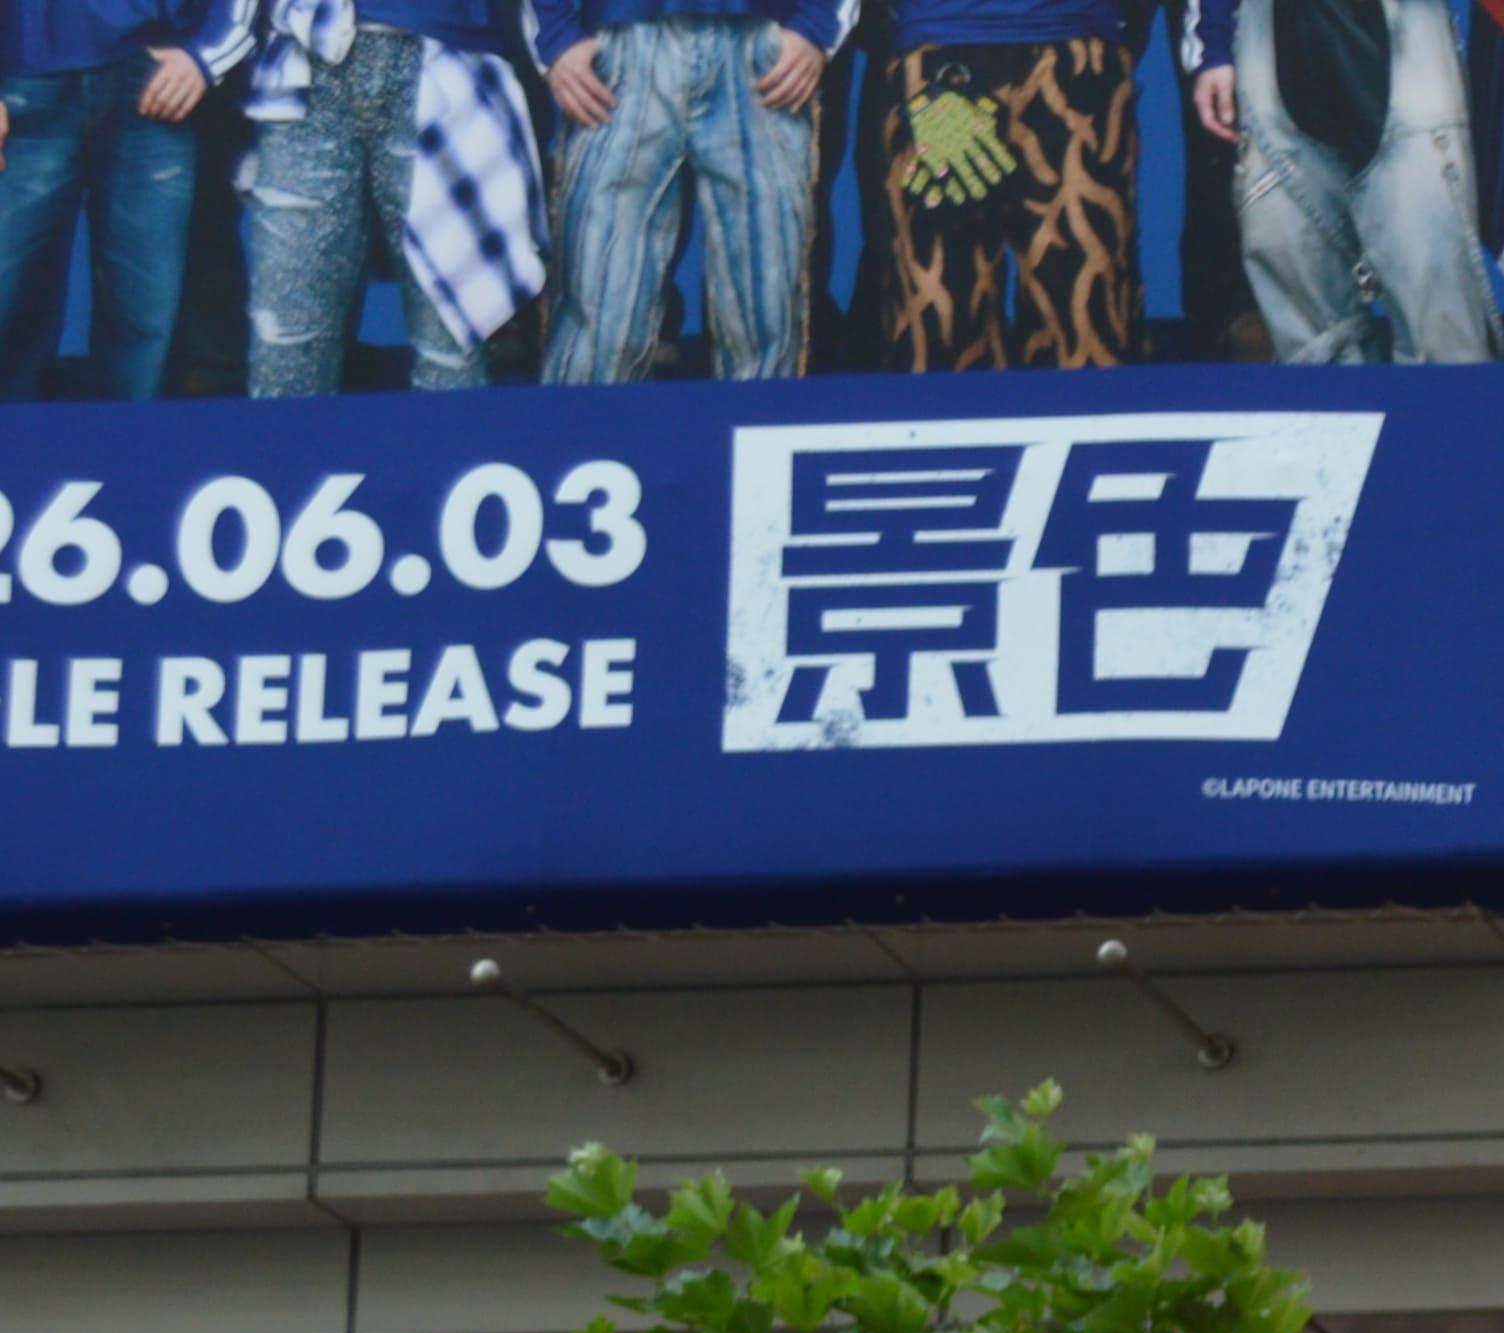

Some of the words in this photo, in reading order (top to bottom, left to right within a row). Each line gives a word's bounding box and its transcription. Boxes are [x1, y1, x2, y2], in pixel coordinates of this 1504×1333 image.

[0, 460, 647, 606] 6.06.03
[772, 440, 1298, 724] 景色
[156, 637, 637, 747] RELEASE
[1306, 779, 1476, 804] ENTERTAINMENT
